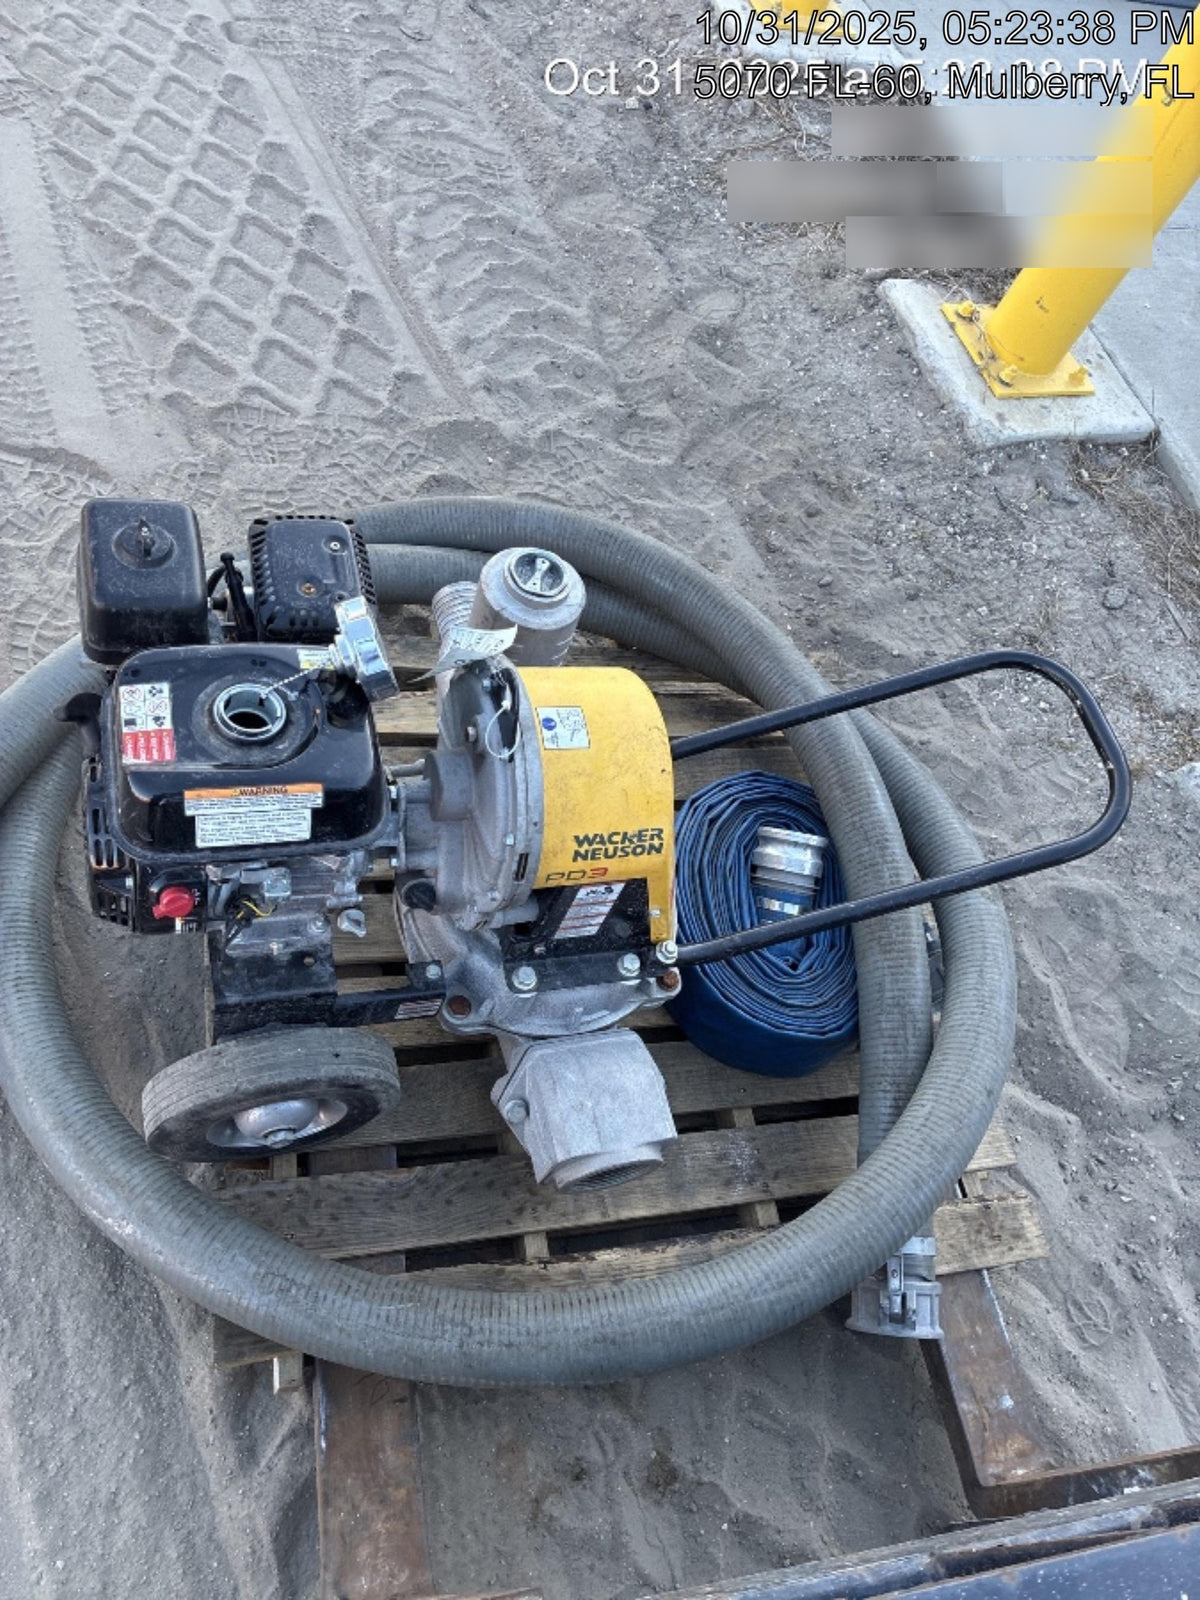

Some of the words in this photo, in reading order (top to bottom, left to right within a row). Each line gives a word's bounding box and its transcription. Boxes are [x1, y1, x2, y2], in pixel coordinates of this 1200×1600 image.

[573, 827, 664, 849] WACKER
[572, 842, 664, 863] NEUSON
[545, 867, 608, 883] PD3
